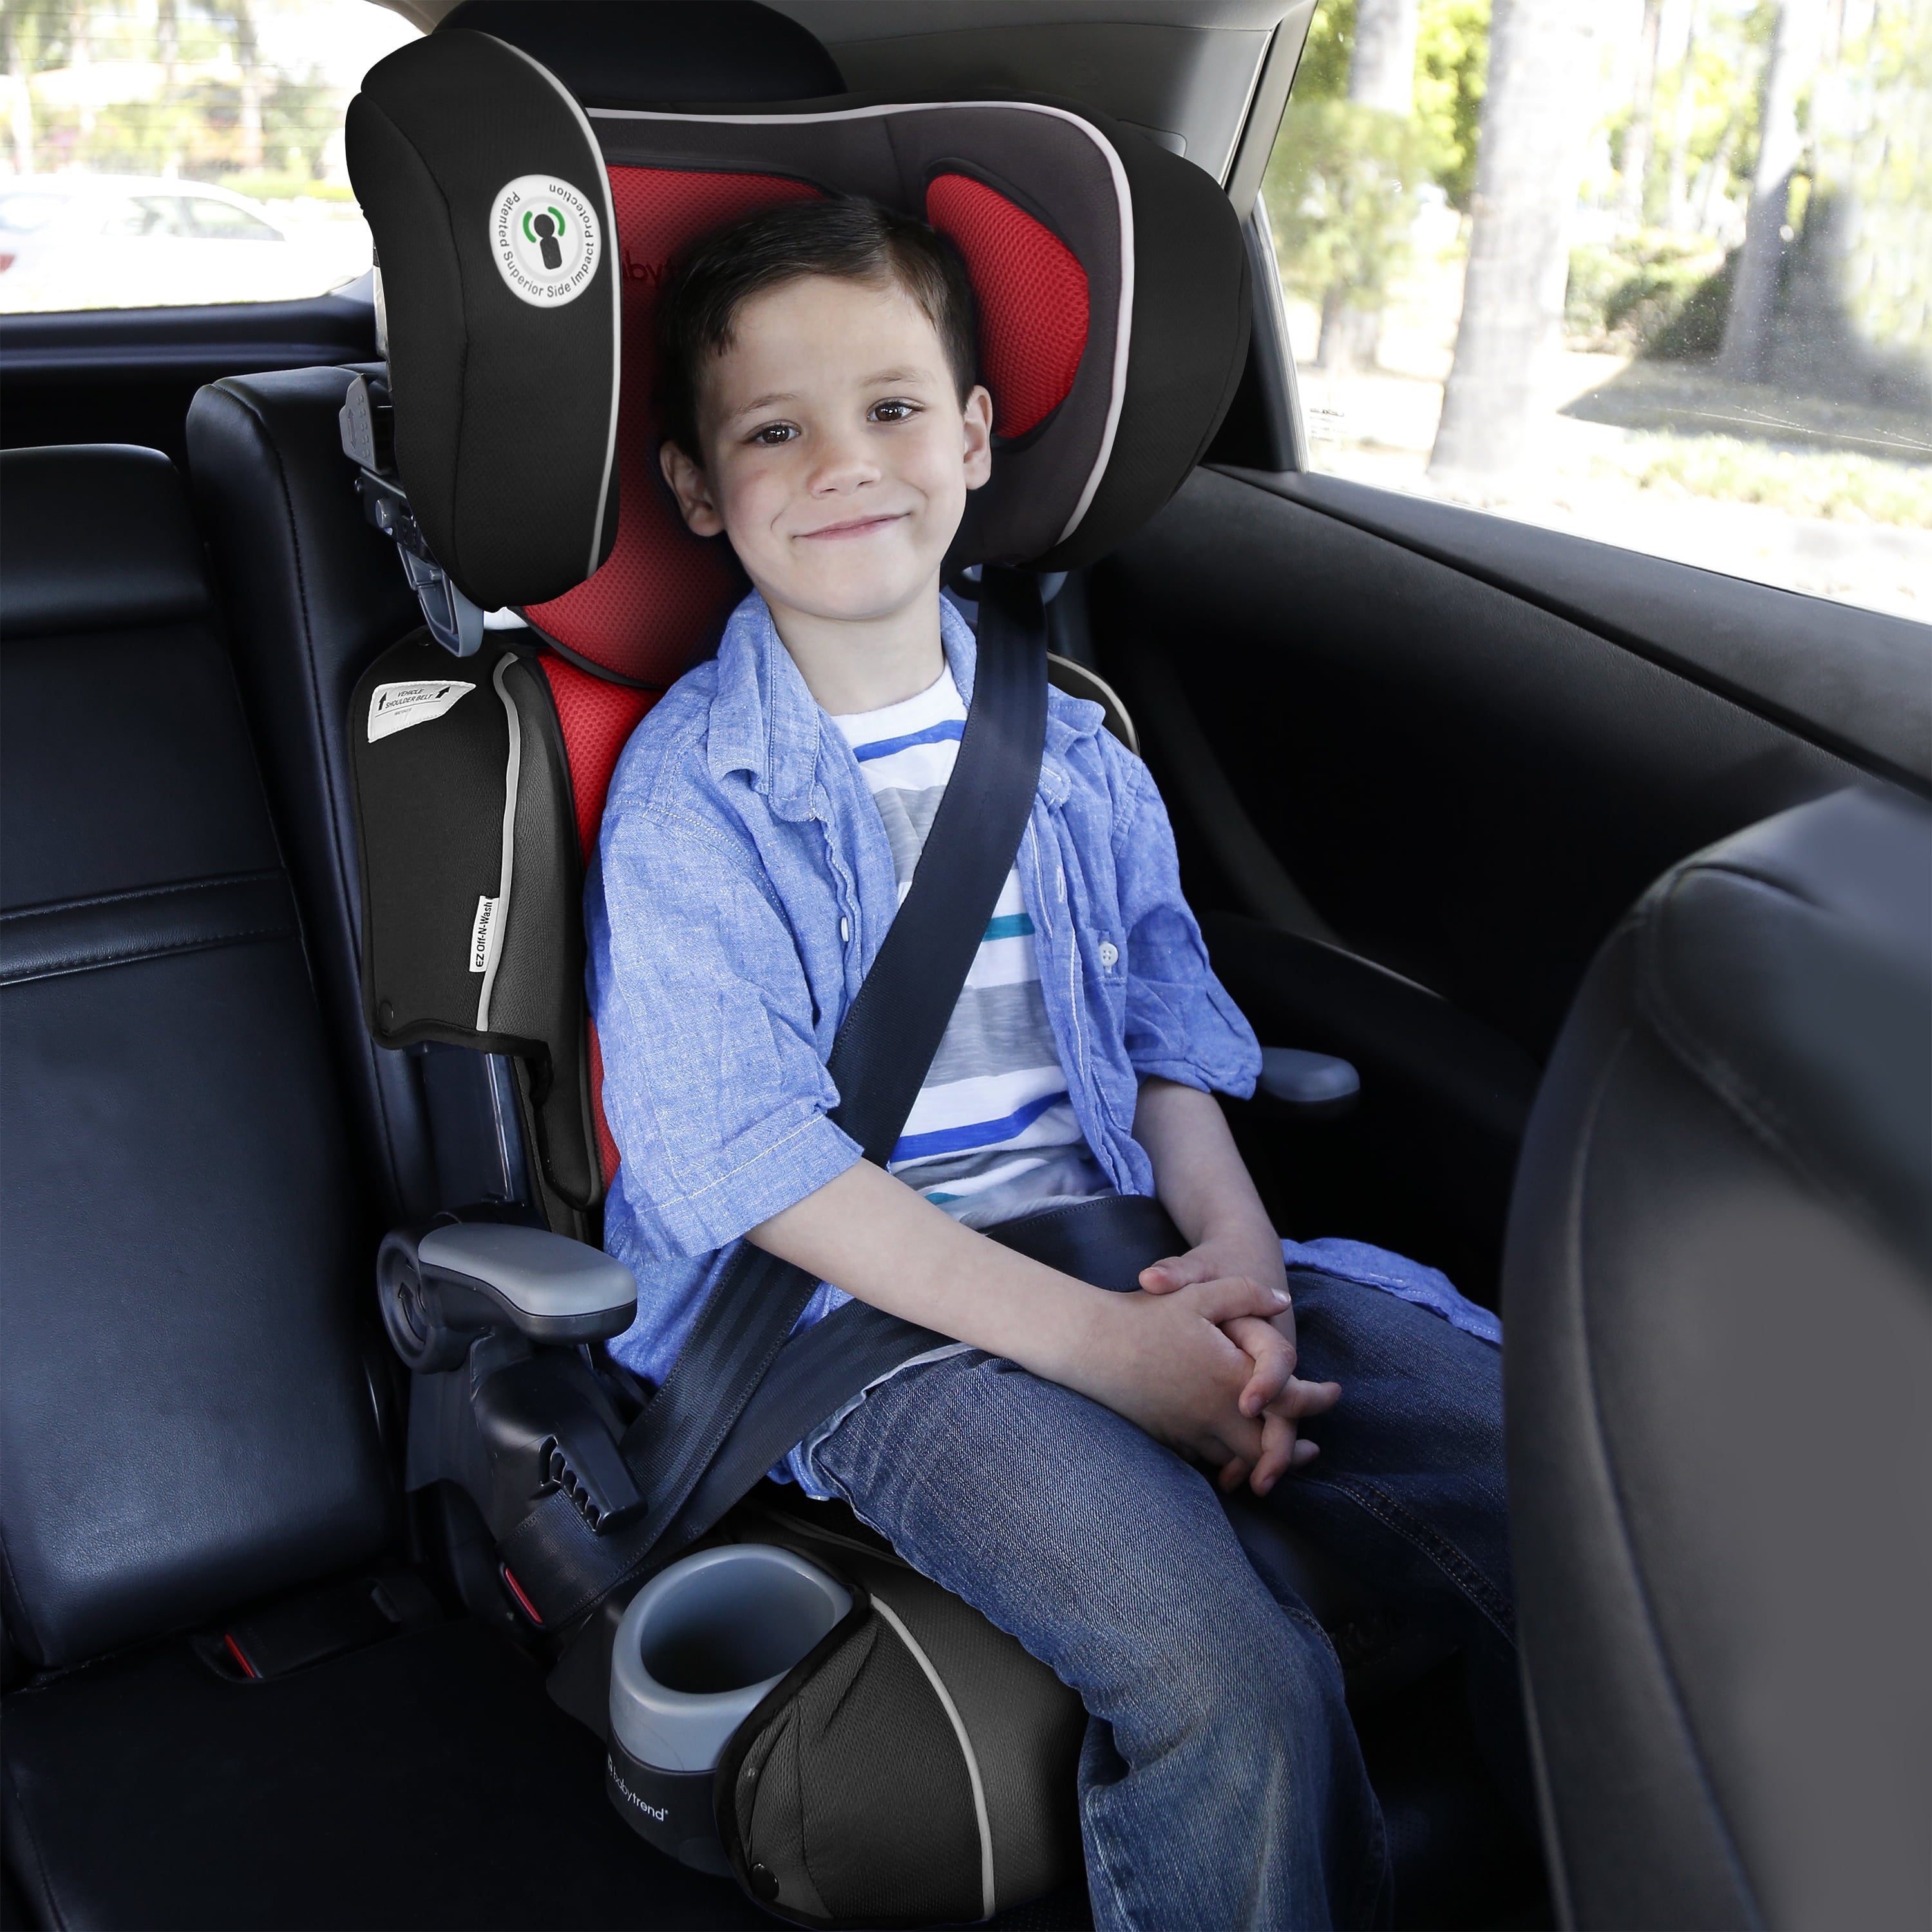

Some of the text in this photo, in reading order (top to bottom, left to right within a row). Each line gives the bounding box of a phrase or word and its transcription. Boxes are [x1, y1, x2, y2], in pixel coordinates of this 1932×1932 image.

[498, 184, 594, 298] Patented Superior Side Impact Protection
[385, 696, 415, 709] SHOULDER
[475, 902, 493, 967] EZ Off-N-Wash
